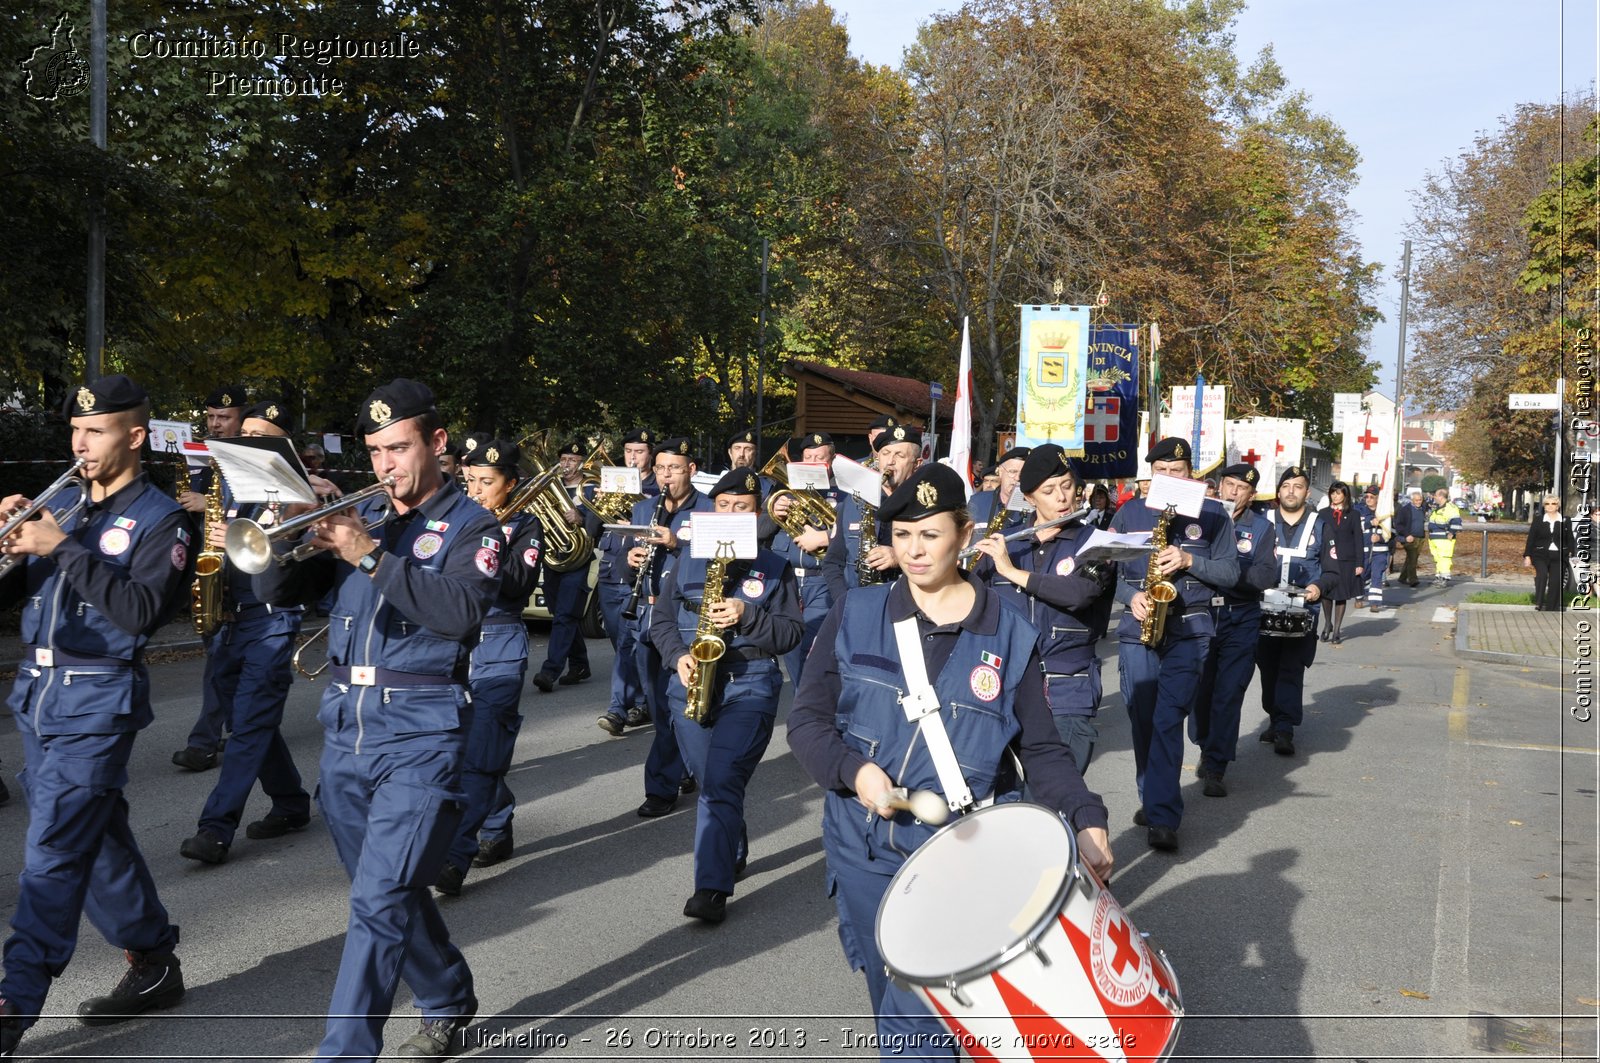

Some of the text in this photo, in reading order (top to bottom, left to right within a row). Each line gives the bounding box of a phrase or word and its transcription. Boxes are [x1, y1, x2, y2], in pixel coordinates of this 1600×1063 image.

[1088, 343, 1131, 362] OVINCIA
[1095, 357, 1106, 365] DI
[1081, 450, 1127, 464] ORINO
[1092, 943, 1101, 957] DI
[1093, 959, 1147, 1003] CONVENZIONE
